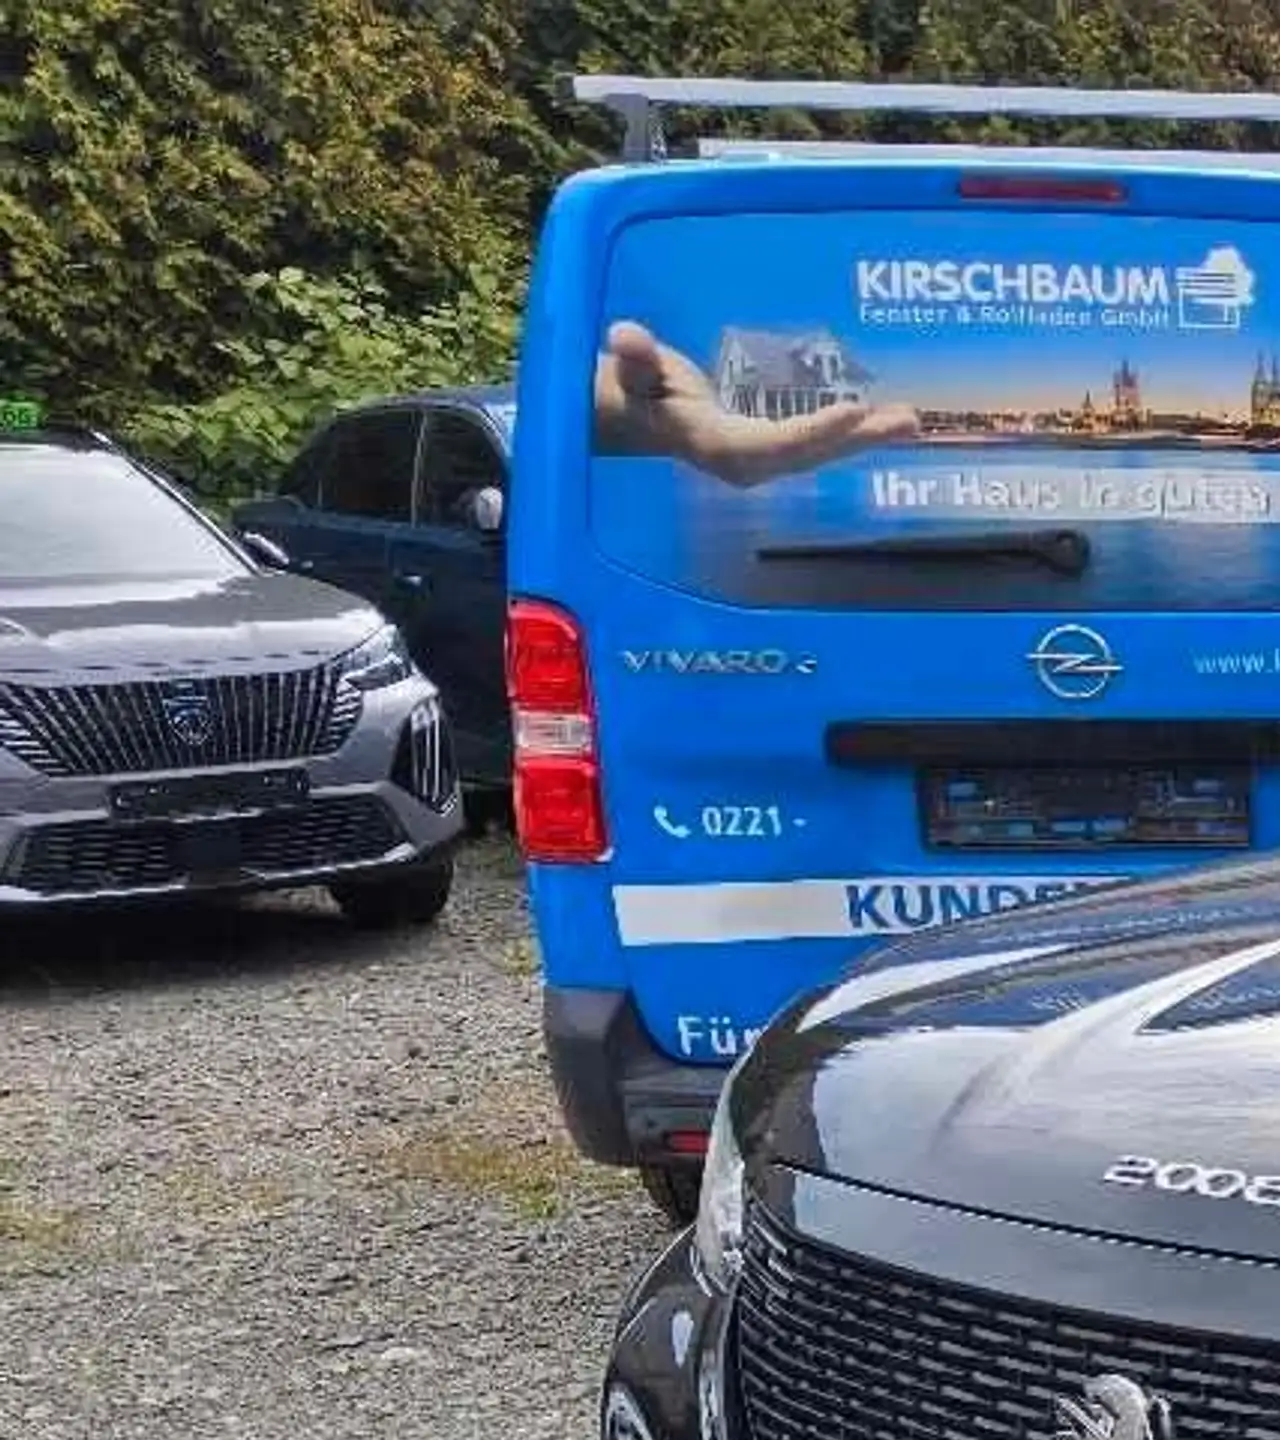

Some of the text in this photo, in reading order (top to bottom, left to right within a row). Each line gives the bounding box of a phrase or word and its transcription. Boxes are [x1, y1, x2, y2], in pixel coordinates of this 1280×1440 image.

[857, 260, 1171, 304] KIRSCHBAUM
[860, 304, 949, 325] Fenster
[1101, 307, 1170, 329] GmbH
[872, 470, 936, 507] Ihr
[951, 471, 1060, 510] Haus
[1137, 474, 1270, 521] guten
[624, 648, 788, 673] VIVARO
[702, 805, 783, 837] 0221
